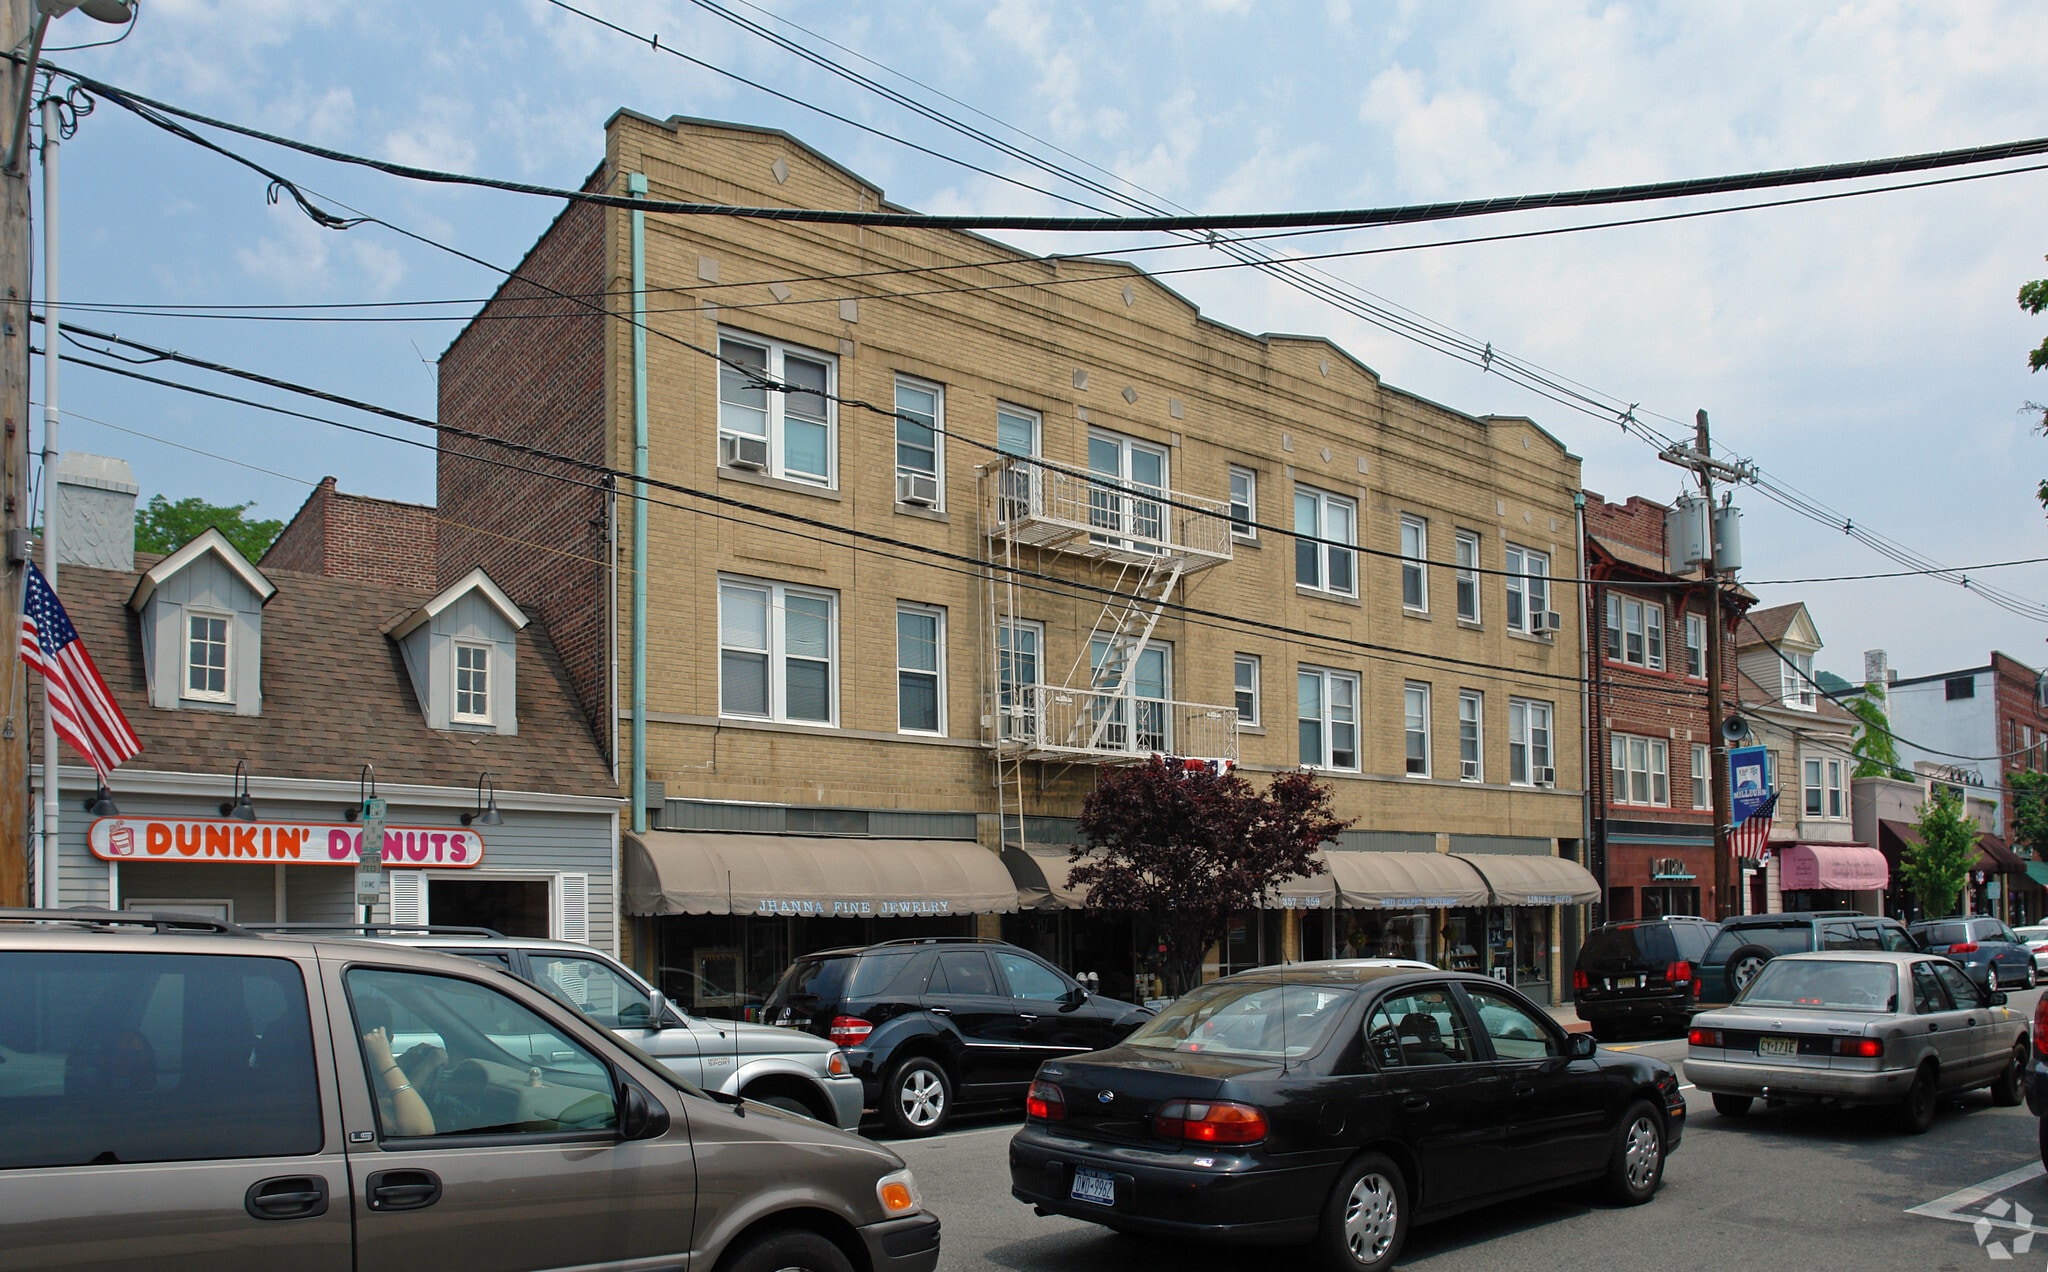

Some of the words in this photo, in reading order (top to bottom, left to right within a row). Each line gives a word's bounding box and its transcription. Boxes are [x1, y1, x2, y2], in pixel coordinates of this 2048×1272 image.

[146, 823, 310, 859] DUNKIN'
[328, 829, 466, 863] DNUTS
[759, 899, 824, 913] JHANNA
[834, 901, 871, 913] FINE
[881, 901, 948, 913] JEWELRY
[1281, 896, 1297, 906] 357
[1305, 896, 1320, 906] 359
[1398, 897, 1423, 907] CARPET
[351, 1132, 373, 1142] LS
